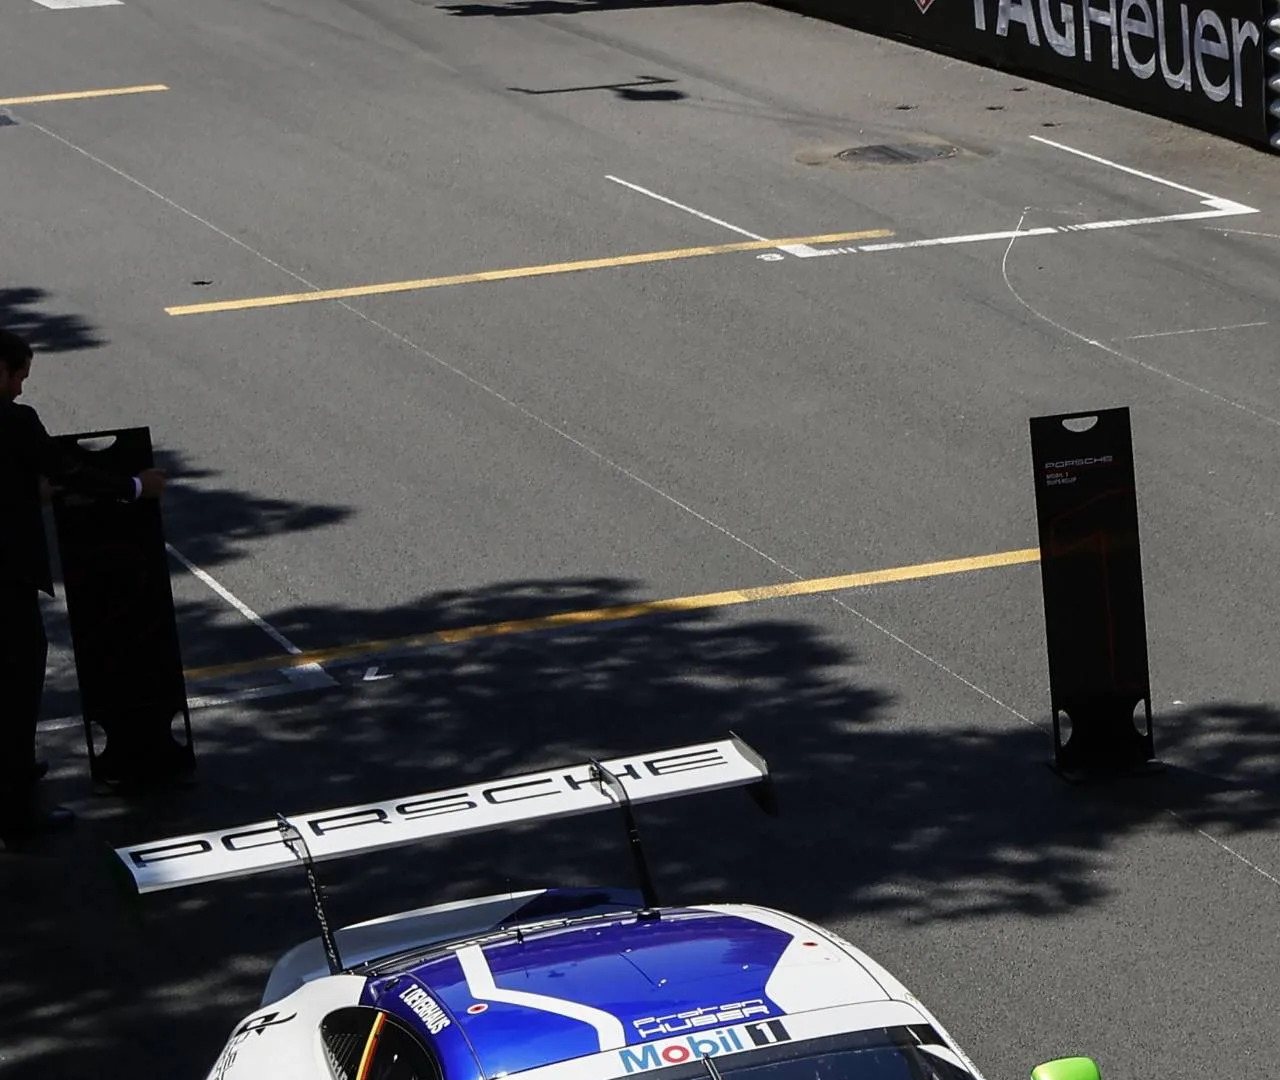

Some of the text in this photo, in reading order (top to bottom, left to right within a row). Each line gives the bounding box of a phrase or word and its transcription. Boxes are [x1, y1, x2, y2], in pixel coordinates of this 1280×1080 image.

[1045, 456, 1113, 469] PORSCHE
[404, 987, 452, 1035] OEVERHAUS
[638, 1005, 771, 1039] HUBER
[619, 1021, 779, 1073] Mobil 1
